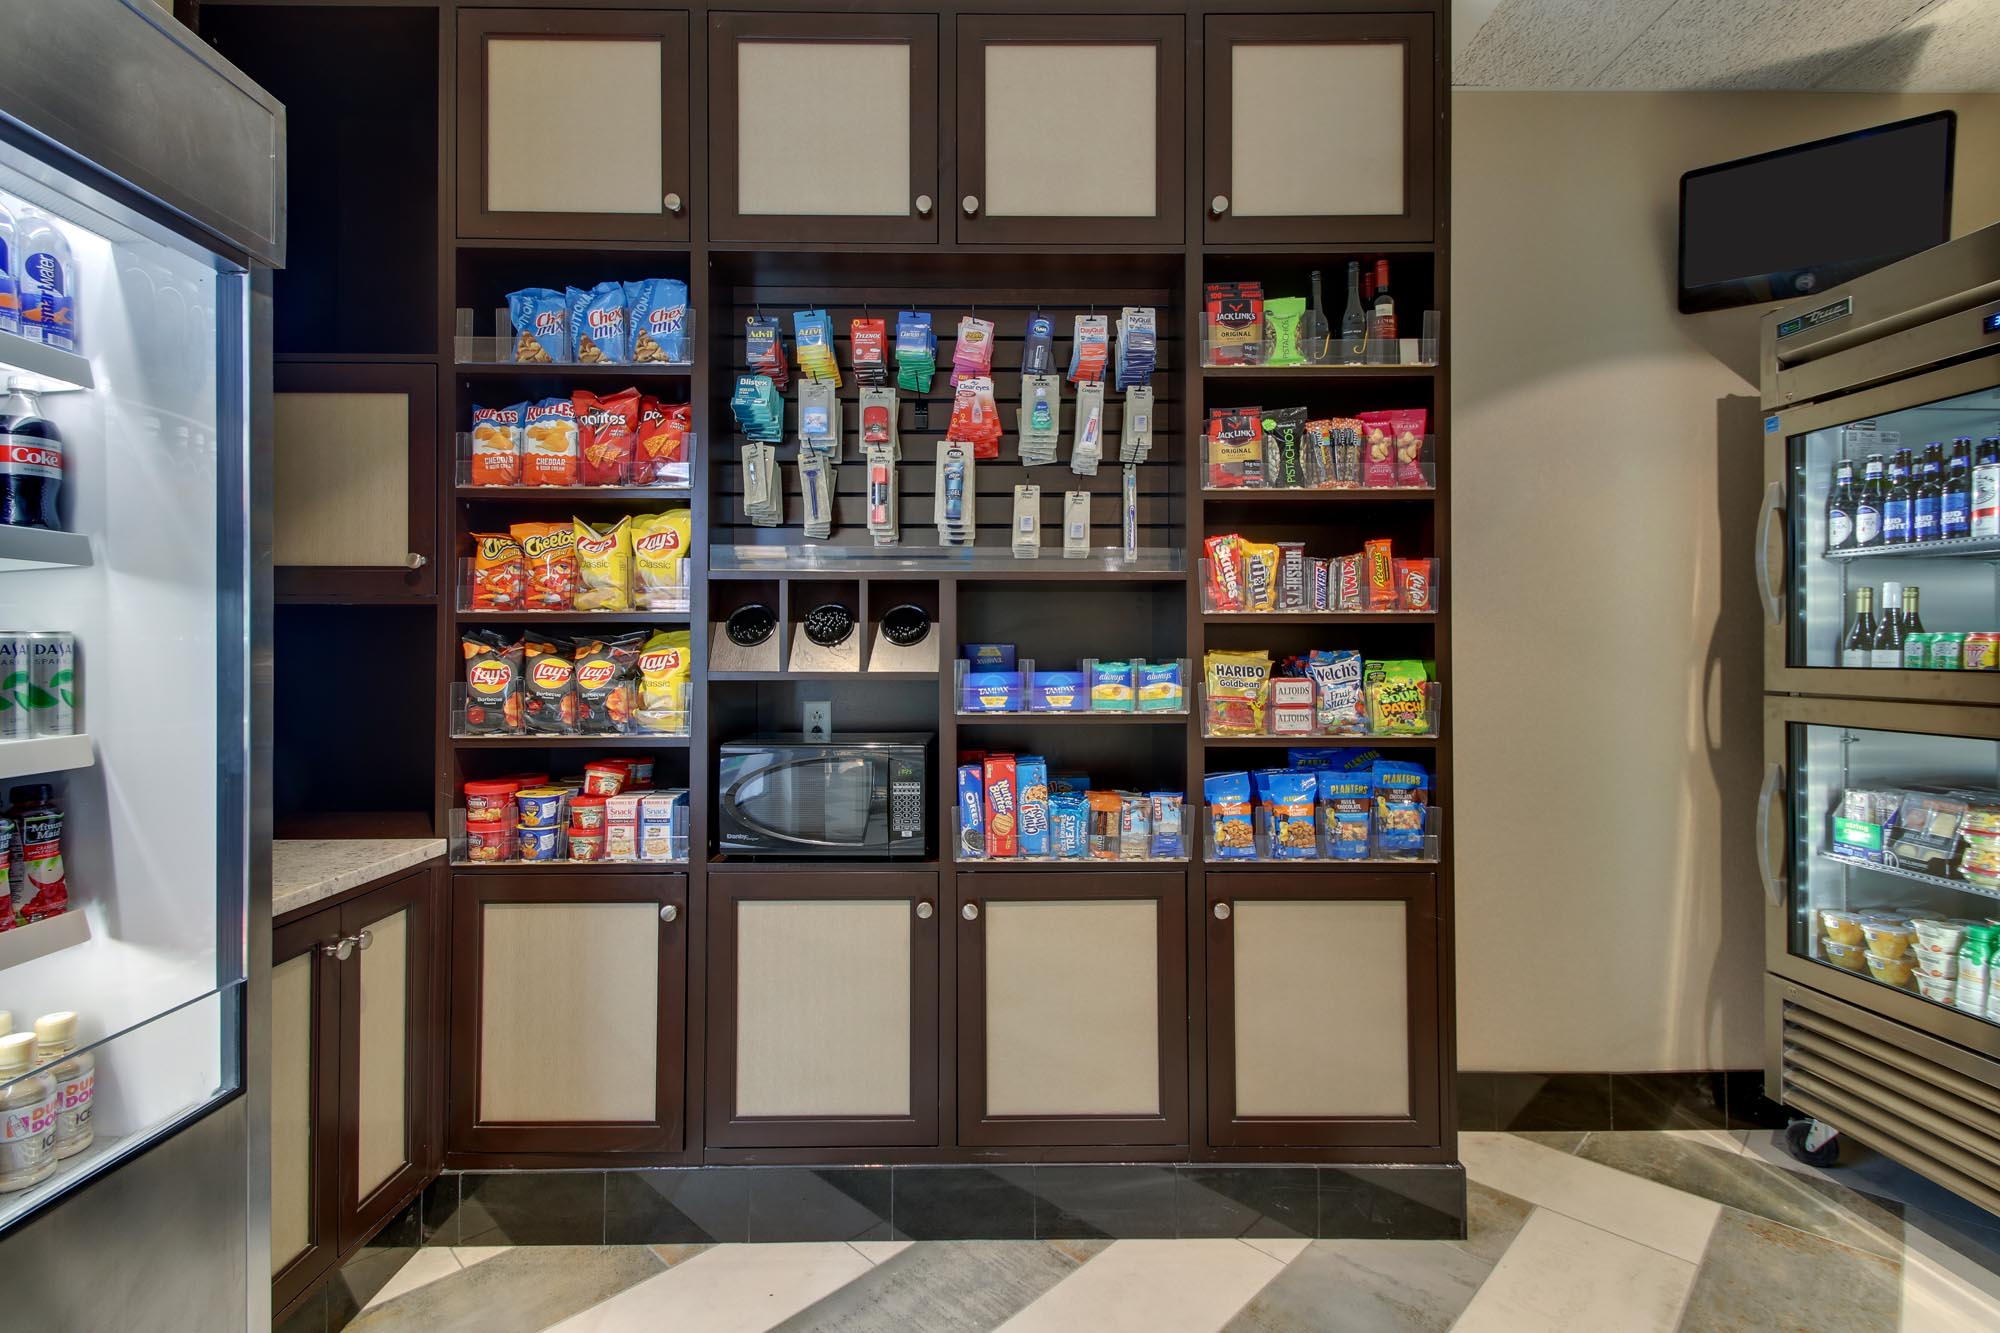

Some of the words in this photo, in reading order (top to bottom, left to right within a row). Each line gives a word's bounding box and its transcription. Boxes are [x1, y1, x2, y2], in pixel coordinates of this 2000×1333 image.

[588, 306, 623, 327] Chex
[649, 304, 686, 324] Chex
[1129, 317, 1151, 325] NyQuil
[1216, 314, 1234, 322] JACK
[593, 320, 623, 339] mix
[651, 317, 682, 335] mix
[748, 331, 773, 339] Advil
[740, 378, 768, 387] Blistex
[1216, 430, 1234, 439] JACK
[12, 447, 59, 467] Coke
[536, 458, 566, 466] CHEDDAR
[1286, 428, 1296, 484] PISTACHIOS
[637, 531, 677, 550] Lay's
[639, 559, 671, 569] Classic
[1216, 545, 1238, 599] Skittles
[1285, 550, 1303, 607] HERSHEY'S
[1342, 559, 1358, 602] TWIX
[1314, 568, 1327, 610] SNICKERS
[639, 653, 679, 671] Lay's
[472, 668, 510, 686] Lay's
[535, 663, 572, 681] Lay's
[579, 665, 615, 680] Lay's
[1099, 672, 1125, 682] always
[1146, 672, 1173, 682] always
[1216, 664, 1265, 678] HARIBO
[1317, 664, 1358, 682] Welch's
[978, 686, 1009, 695] TAMPAX
[1044, 685, 1076, 695] TAMPAX
[1278, 687, 1310, 695] ALTOIDS
[1330, 690, 1352, 701] Fruit
[1381, 690, 1419, 703] SOUR
[1325, 697, 1357, 708] Snacks
[1382, 703, 1420, 716] PATCH
[1278, 713, 1310, 721] ALTOIDS
[1383, 774, 1420, 786] PLANTERS
[997, 780, 1014, 812] Nutter
[1330, 784, 1368, 795] PLANTERS
[989, 785, 1007, 816] Butter
[965, 792, 978, 826] OREO
[1025, 810, 1039, 835] Chips
[37, 829, 61, 840] Maid
[726, 833, 747, 841] Danby
[1066, 815, 1076, 849] TREATS
